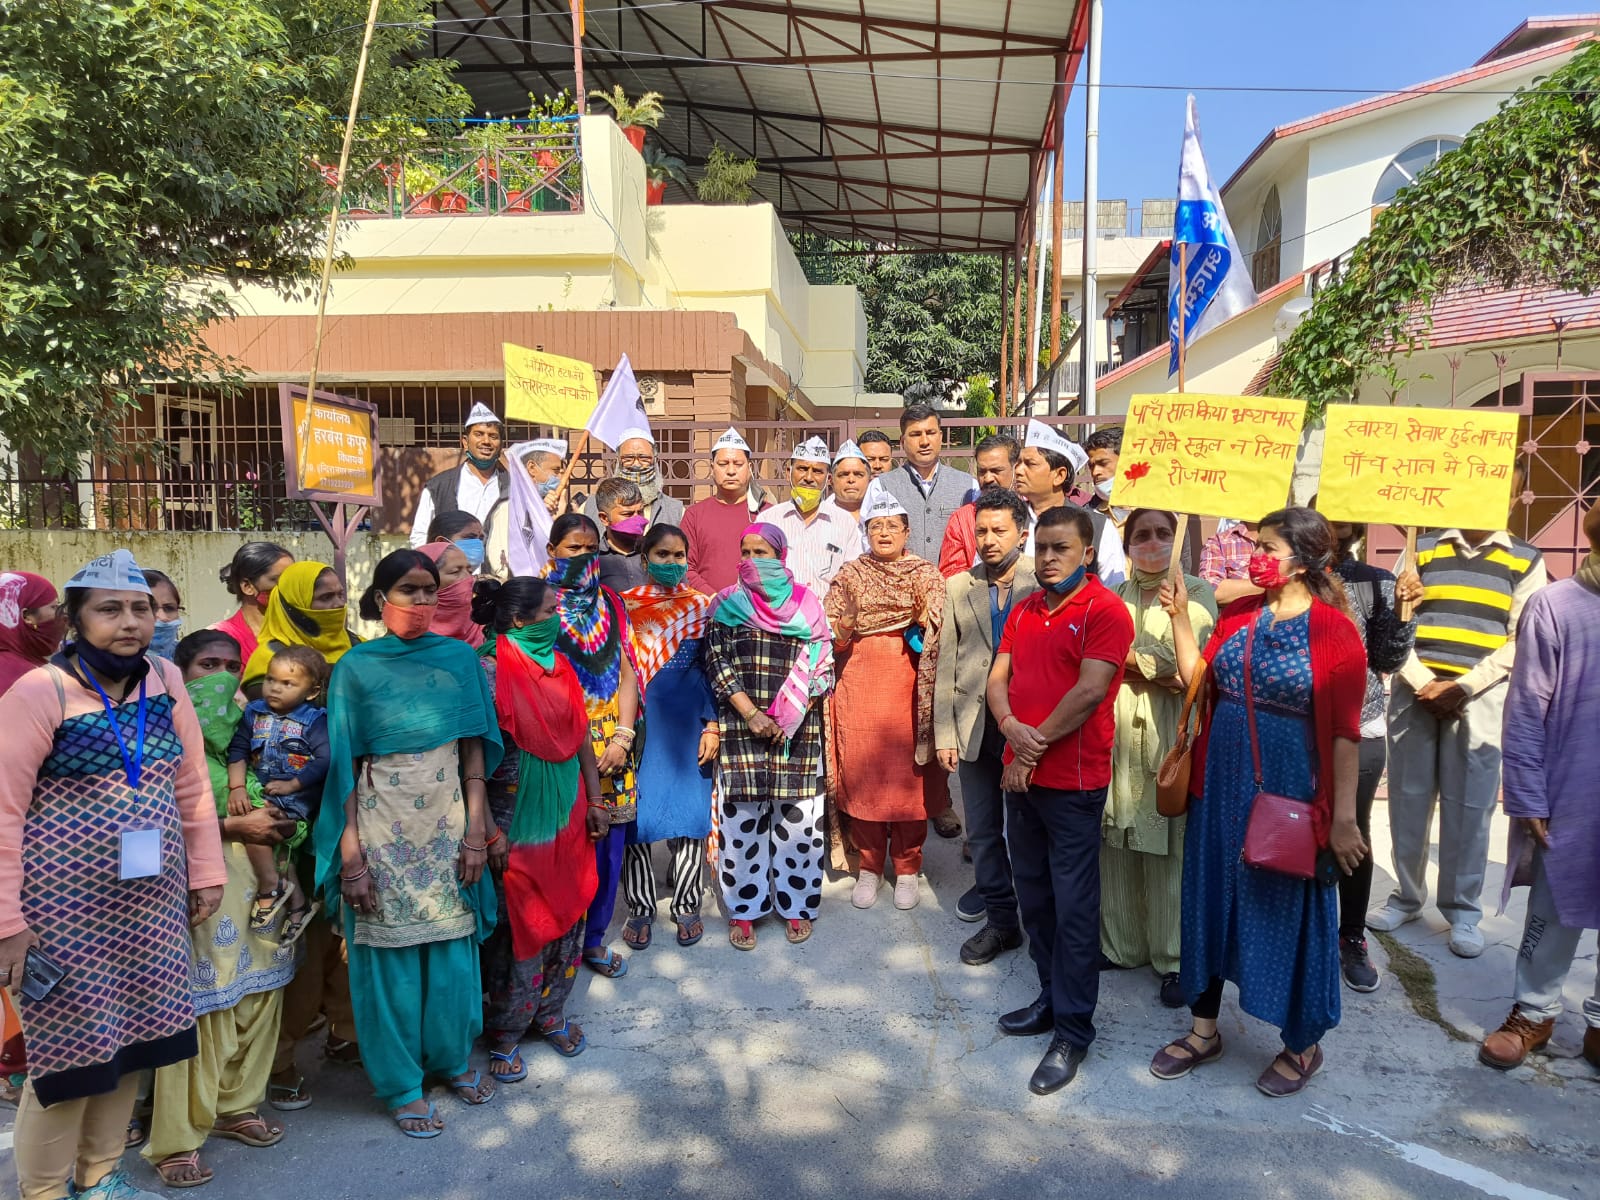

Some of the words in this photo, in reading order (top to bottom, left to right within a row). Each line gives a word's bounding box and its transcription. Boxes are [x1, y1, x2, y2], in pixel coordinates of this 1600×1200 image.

[314, 408, 351, 425] कार्यालय
[1196, 400, 1229, 422] किया
[346, 433, 368, 455] कपूर
[1132, 438, 1147, 455] न
[1184, 437, 1225, 459] स्कूल
[1230, 439, 1252, 455] न
[1254, 435, 1296, 460] दिया
[1168, 459, 1229, 492] रोजगार
[1392, 458, 1435, 477] साल
[1443, 451, 1462, 476] में
[1467, 454, 1510, 480] किया
[1520, 915, 1546, 960] NIKE
